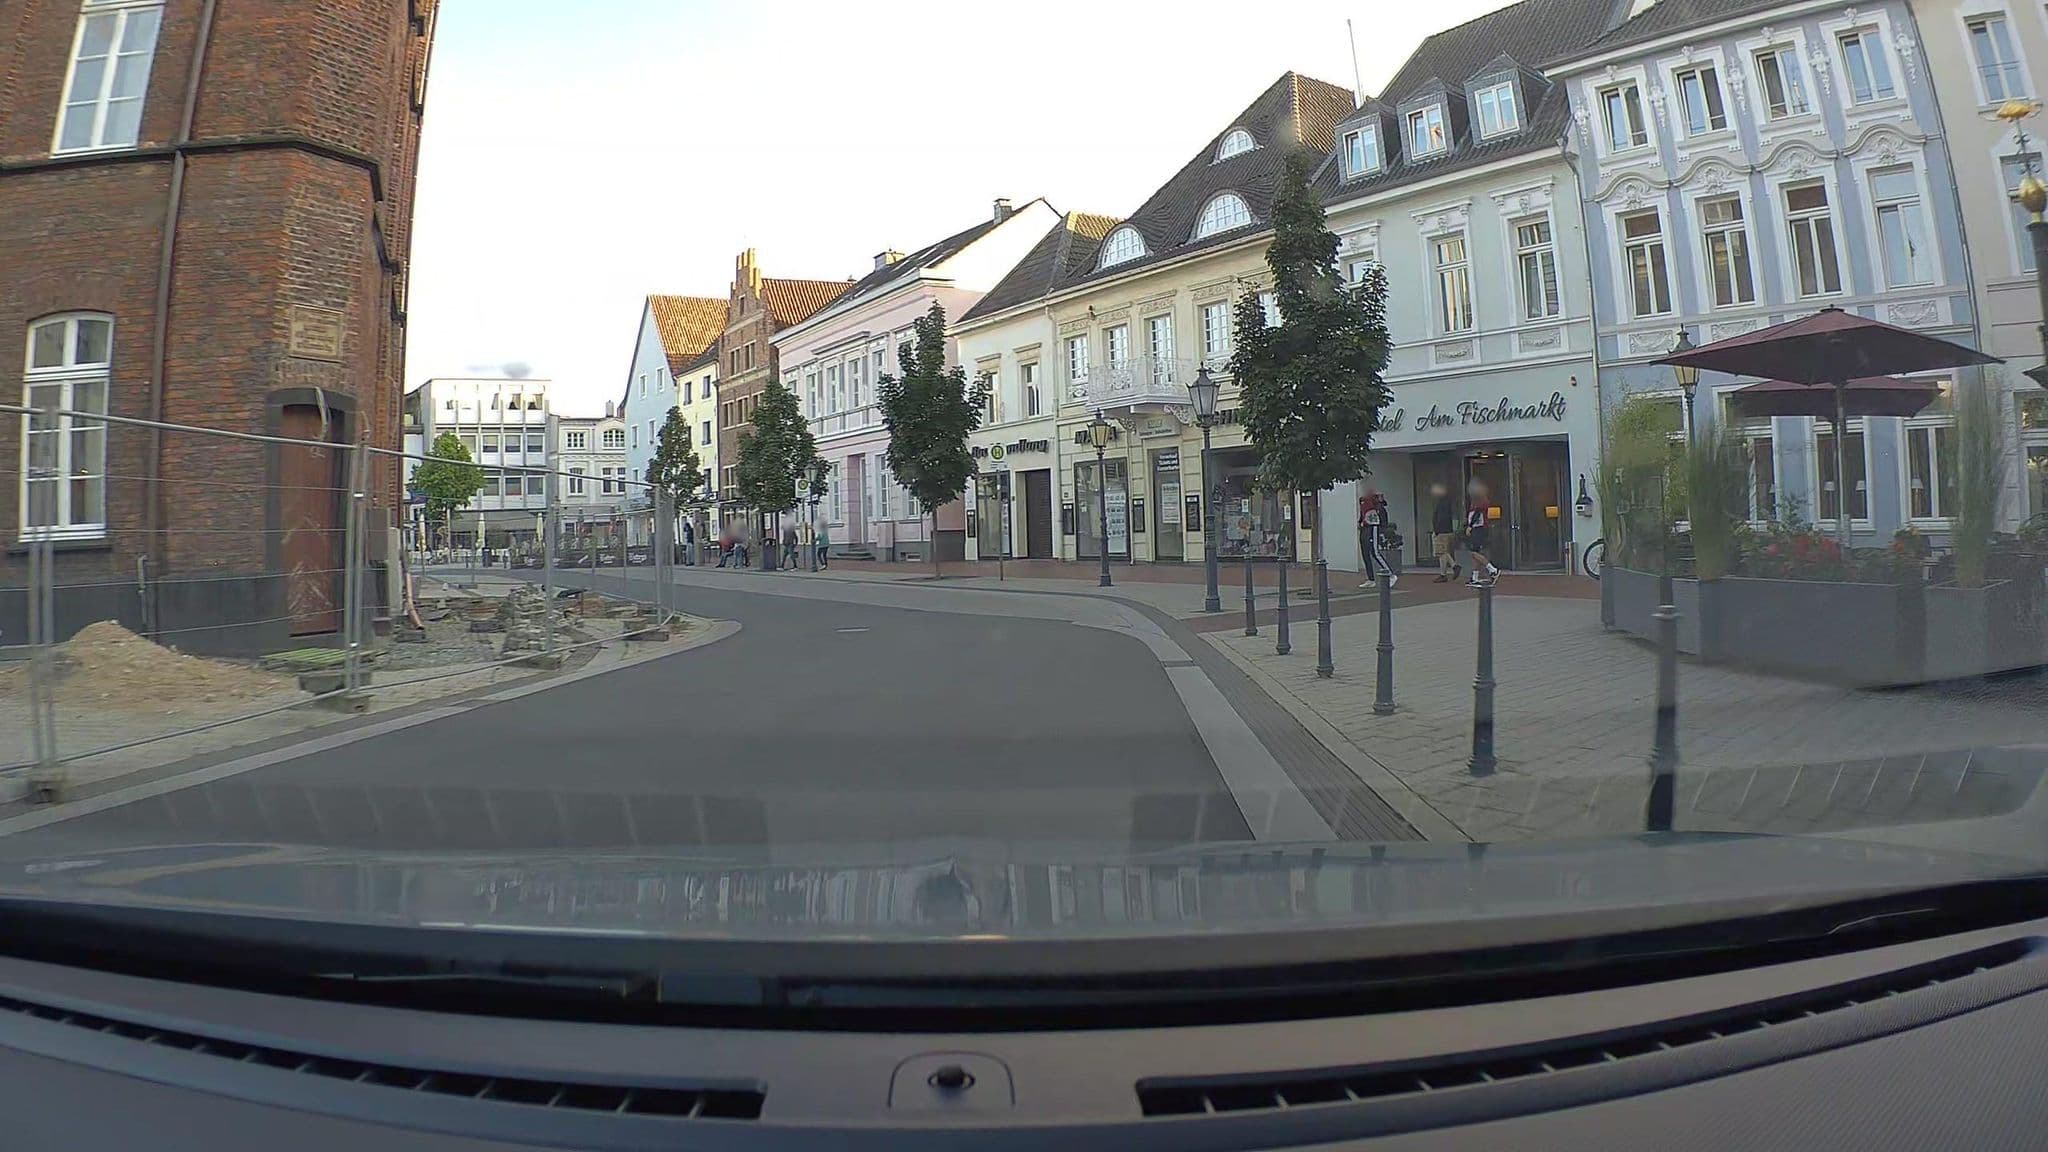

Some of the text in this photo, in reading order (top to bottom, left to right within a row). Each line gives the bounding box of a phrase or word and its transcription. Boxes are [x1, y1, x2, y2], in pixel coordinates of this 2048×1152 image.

[1380, 391, 1567, 432] tel Am Fischmarkt
